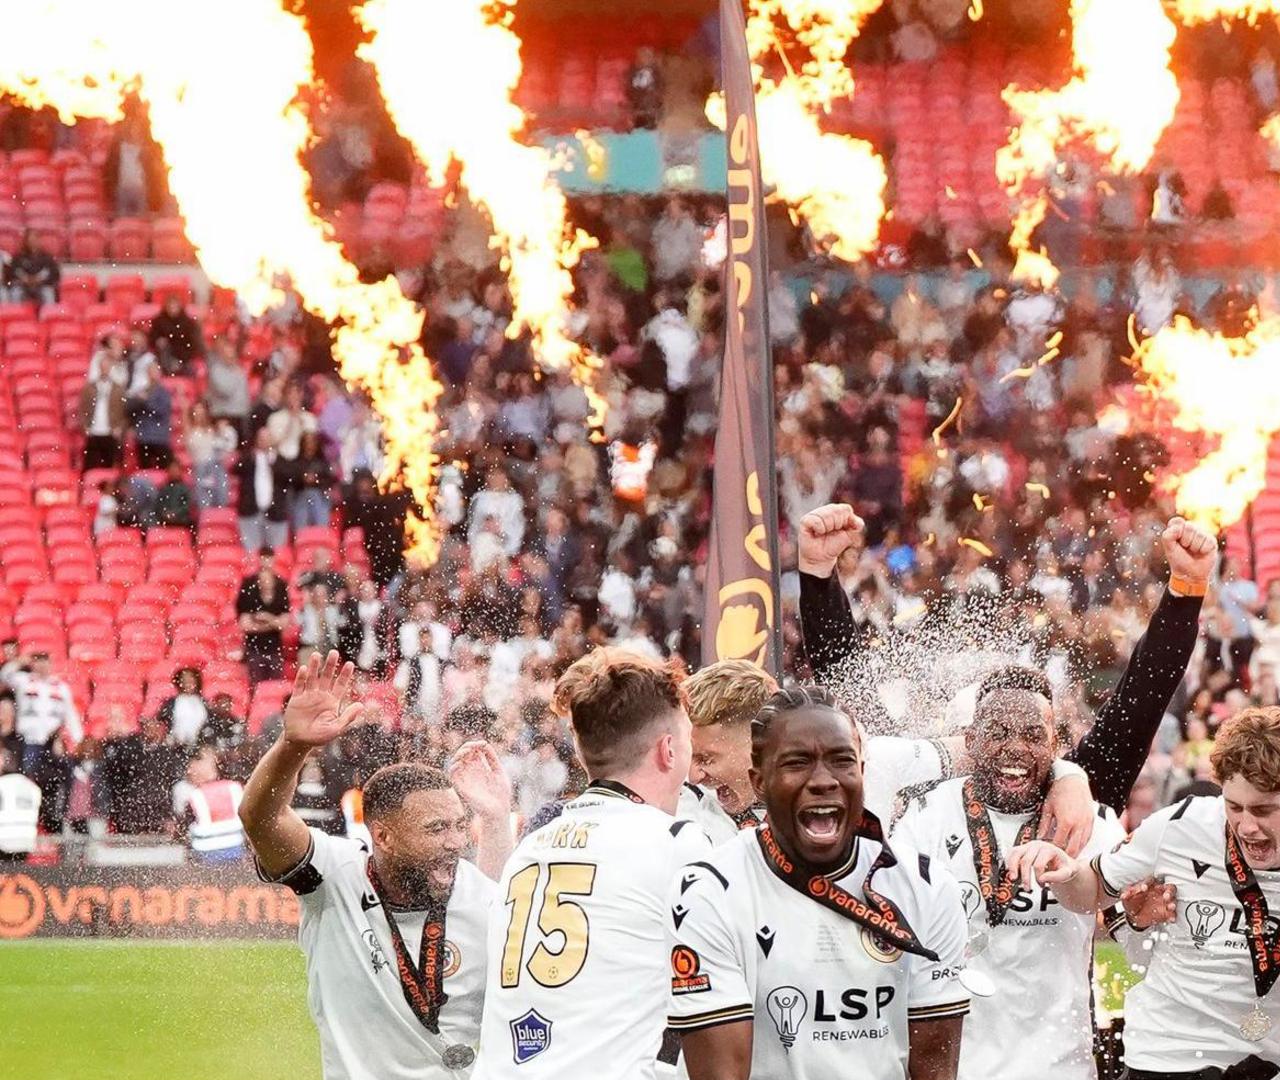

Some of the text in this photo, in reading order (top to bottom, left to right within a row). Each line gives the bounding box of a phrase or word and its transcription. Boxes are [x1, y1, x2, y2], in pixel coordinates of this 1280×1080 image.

[761, 829, 795, 876] arama
[828, 887, 912, 941] vanarama
[1008, 886, 1060, 913] SP
[501, 862, 597, 988] 15
[985, 916, 1059, 928] NEWABLES
[424, 940, 438, 1004] vanara
[814, 985, 895, 1023] LSP
[516, 1025, 546, 1041] blue
